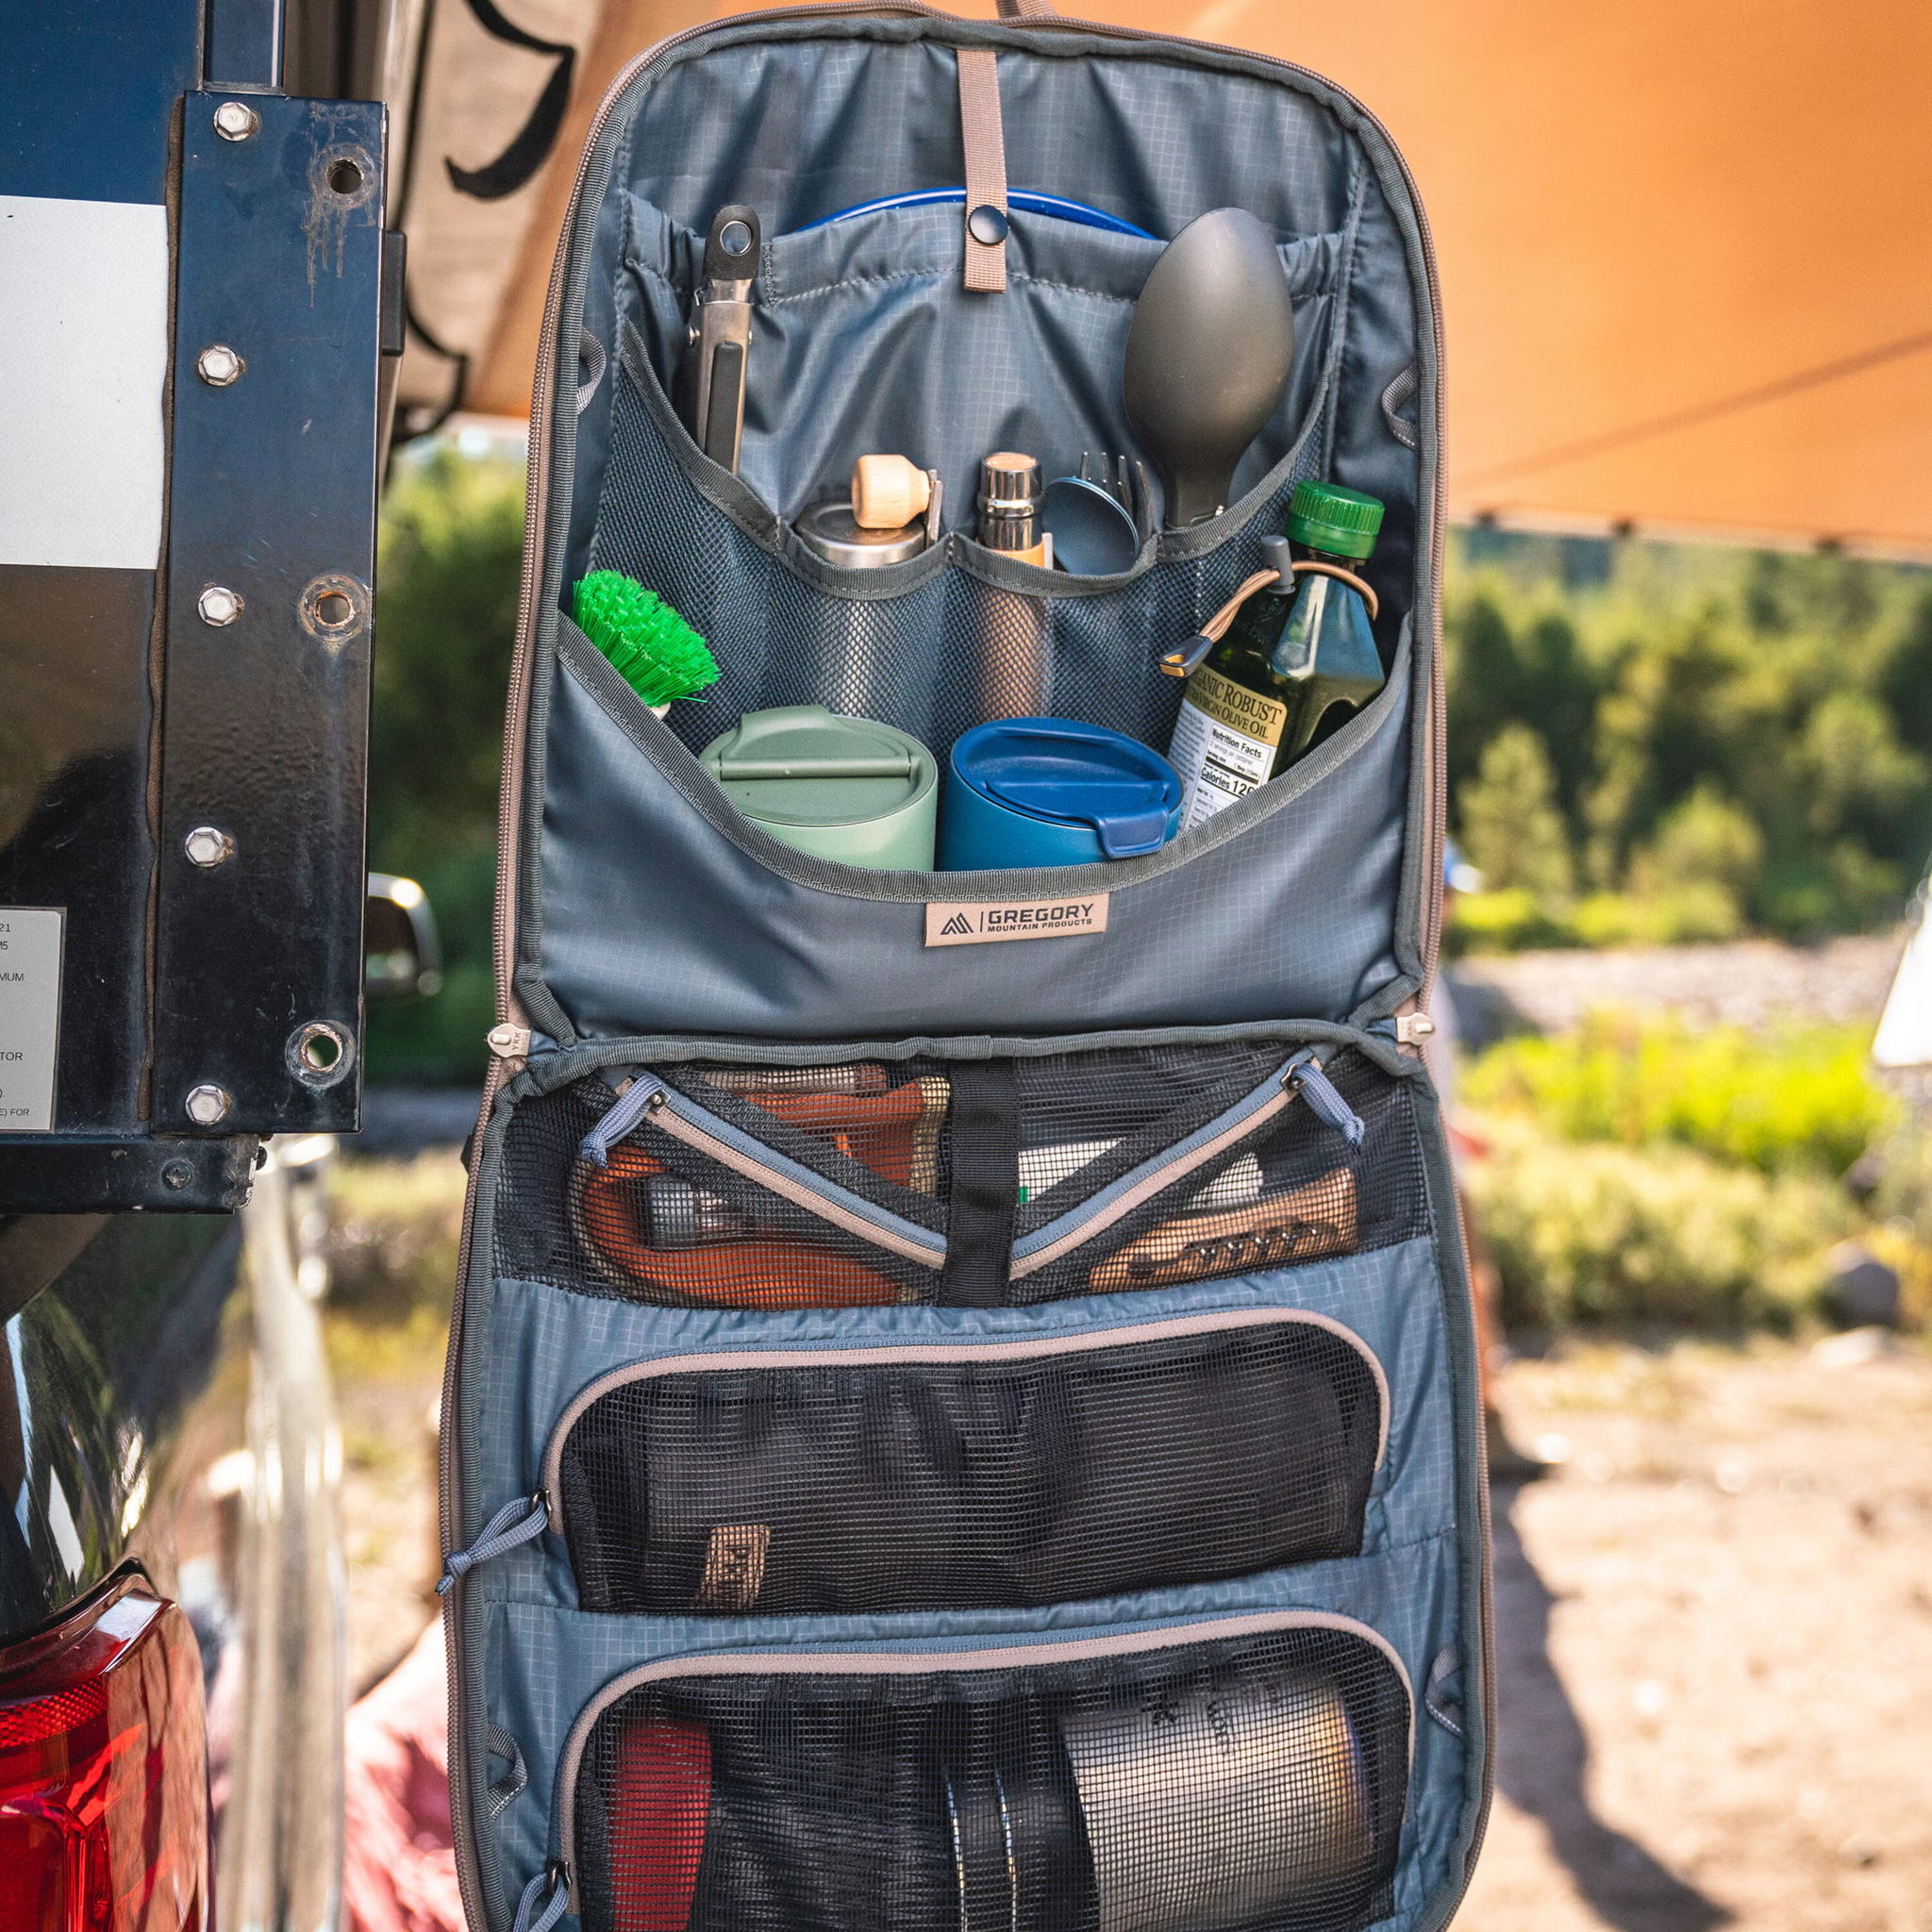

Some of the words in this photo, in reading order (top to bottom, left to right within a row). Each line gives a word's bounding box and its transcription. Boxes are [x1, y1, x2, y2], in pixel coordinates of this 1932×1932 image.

[1223, 684, 1282, 724] ROBUST
[1222, 707, 1249, 731] OLIVE
[1250, 721, 1268, 739] OIL
[1212, 728, 1240, 747] Nutrition
[1241, 742, 1262, 758] Facts
[1201, 767, 1230, 790] Calories
[988, 903, 1094, 924] GREGORY
[987, 924, 1038, 932] MOUNTAIN
[1041, 918, 1092, 929] PRODUCTS
[0, 973, 25, 981] MUM
[512, 1032, 521, 1051] YKK
[0, 1052, 23, 1060] TOR
